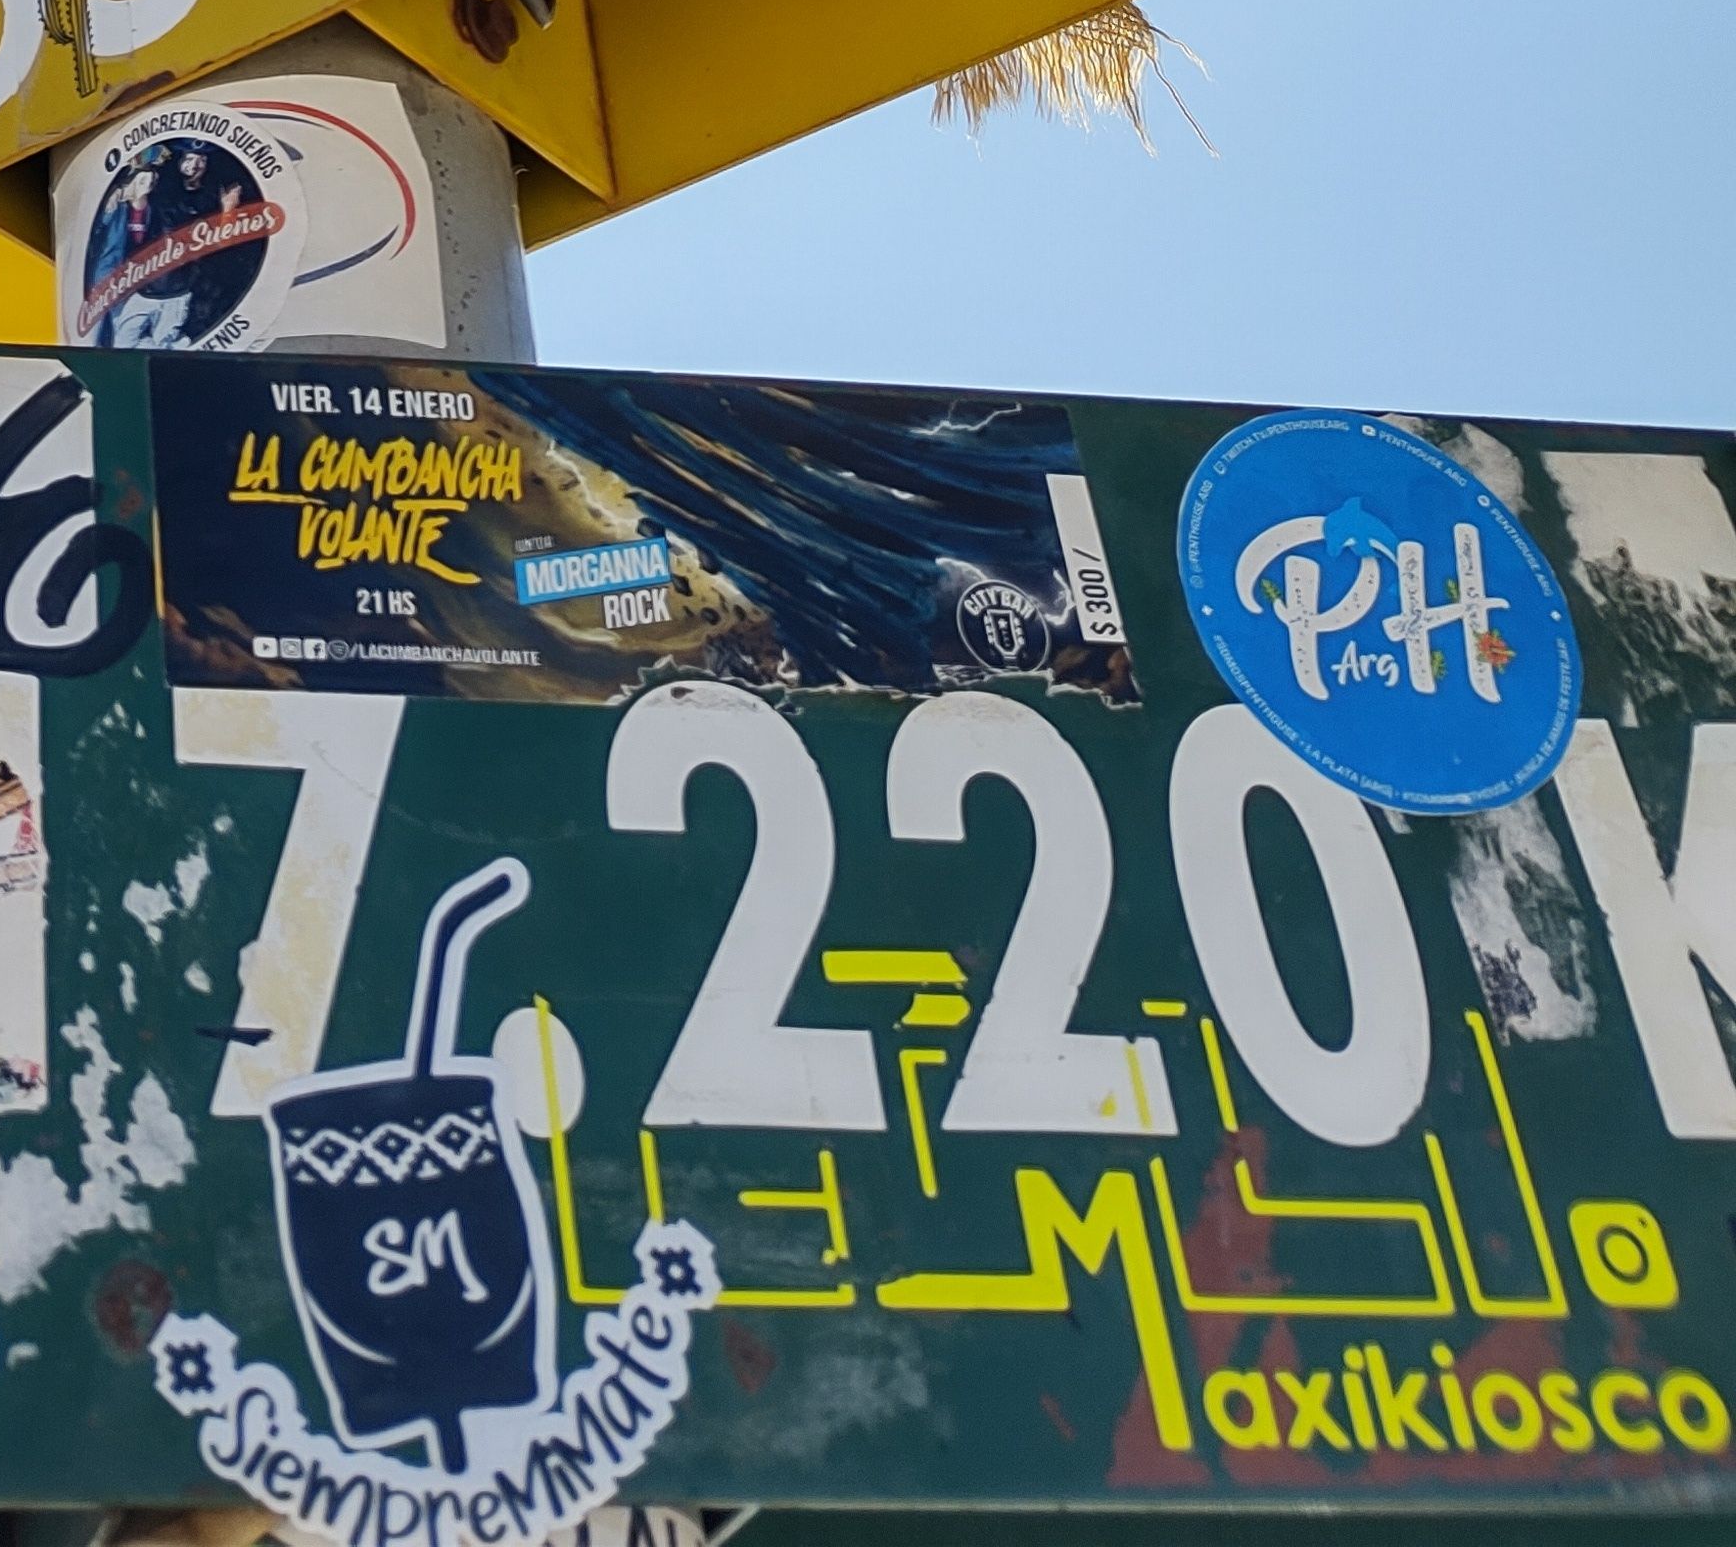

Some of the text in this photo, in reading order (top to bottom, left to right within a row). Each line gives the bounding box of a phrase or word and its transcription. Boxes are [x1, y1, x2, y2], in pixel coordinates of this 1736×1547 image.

[122, 110, 284, 182] CONCRETANDO SUEÑOS
[76, 235, 189, 333] Concretando
[188, 203, 277, 255] Sueños
[269, 381, 476, 423] VIER. 14 ENERO
[232, 431, 524, 511] LA CUMBANCHA
[1378, 428, 1443, 471] PENTHOUSE
[296, 503, 484, 585] VOLANTE
[524, 541, 667, 599] MORGANNA
[356, 589, 418, 617] 21 HS
[602, 588, 672, 630] ROCK
[960, 587, 1040, 623] CITY BAR
[1082, 566, 1114, 617] 300
[1233, 519, 1511, 706] PH
[1331, 639, 1402, 689] Arg
[363, 1209, 489, 1301] SM
